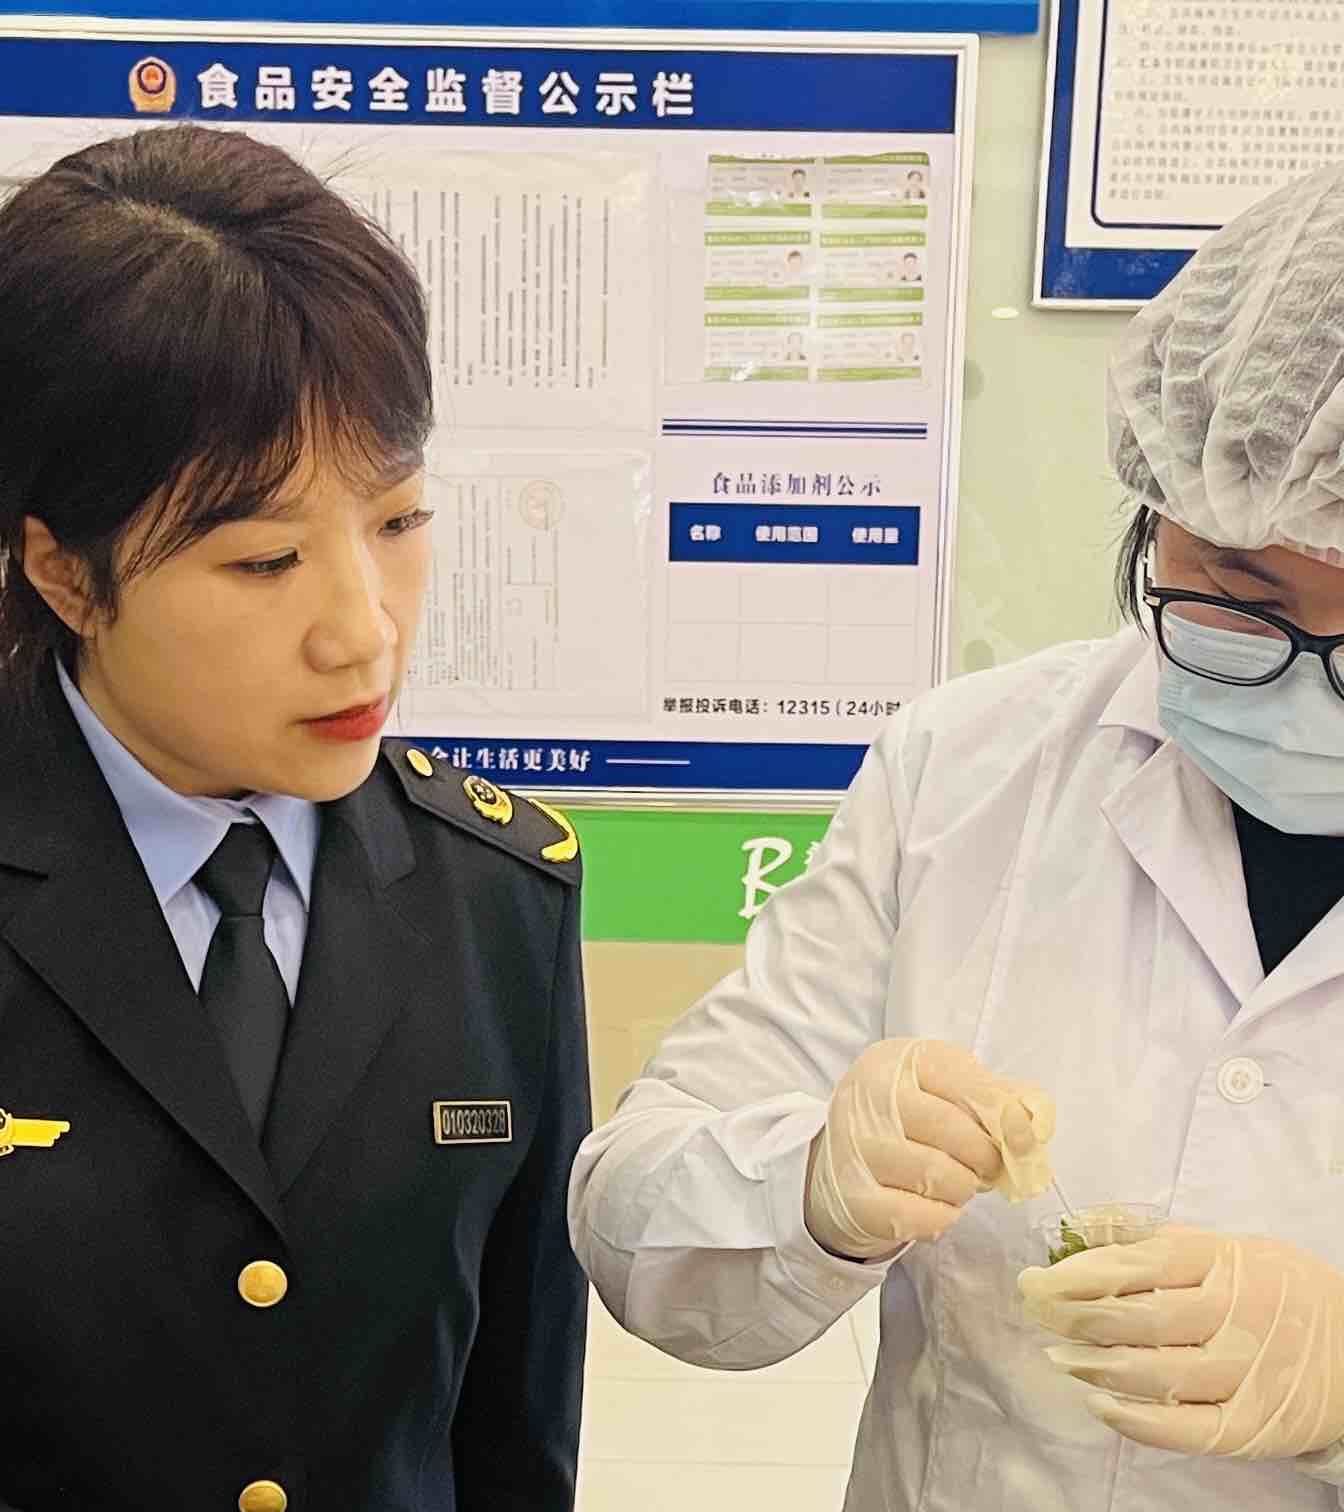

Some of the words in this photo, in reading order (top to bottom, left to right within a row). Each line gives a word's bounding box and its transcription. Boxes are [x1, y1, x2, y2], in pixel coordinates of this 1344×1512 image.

[197, 62, 695, 117] 食品安全监督公示栏
[713, 471, 882, 497] 食品添加剂公示
